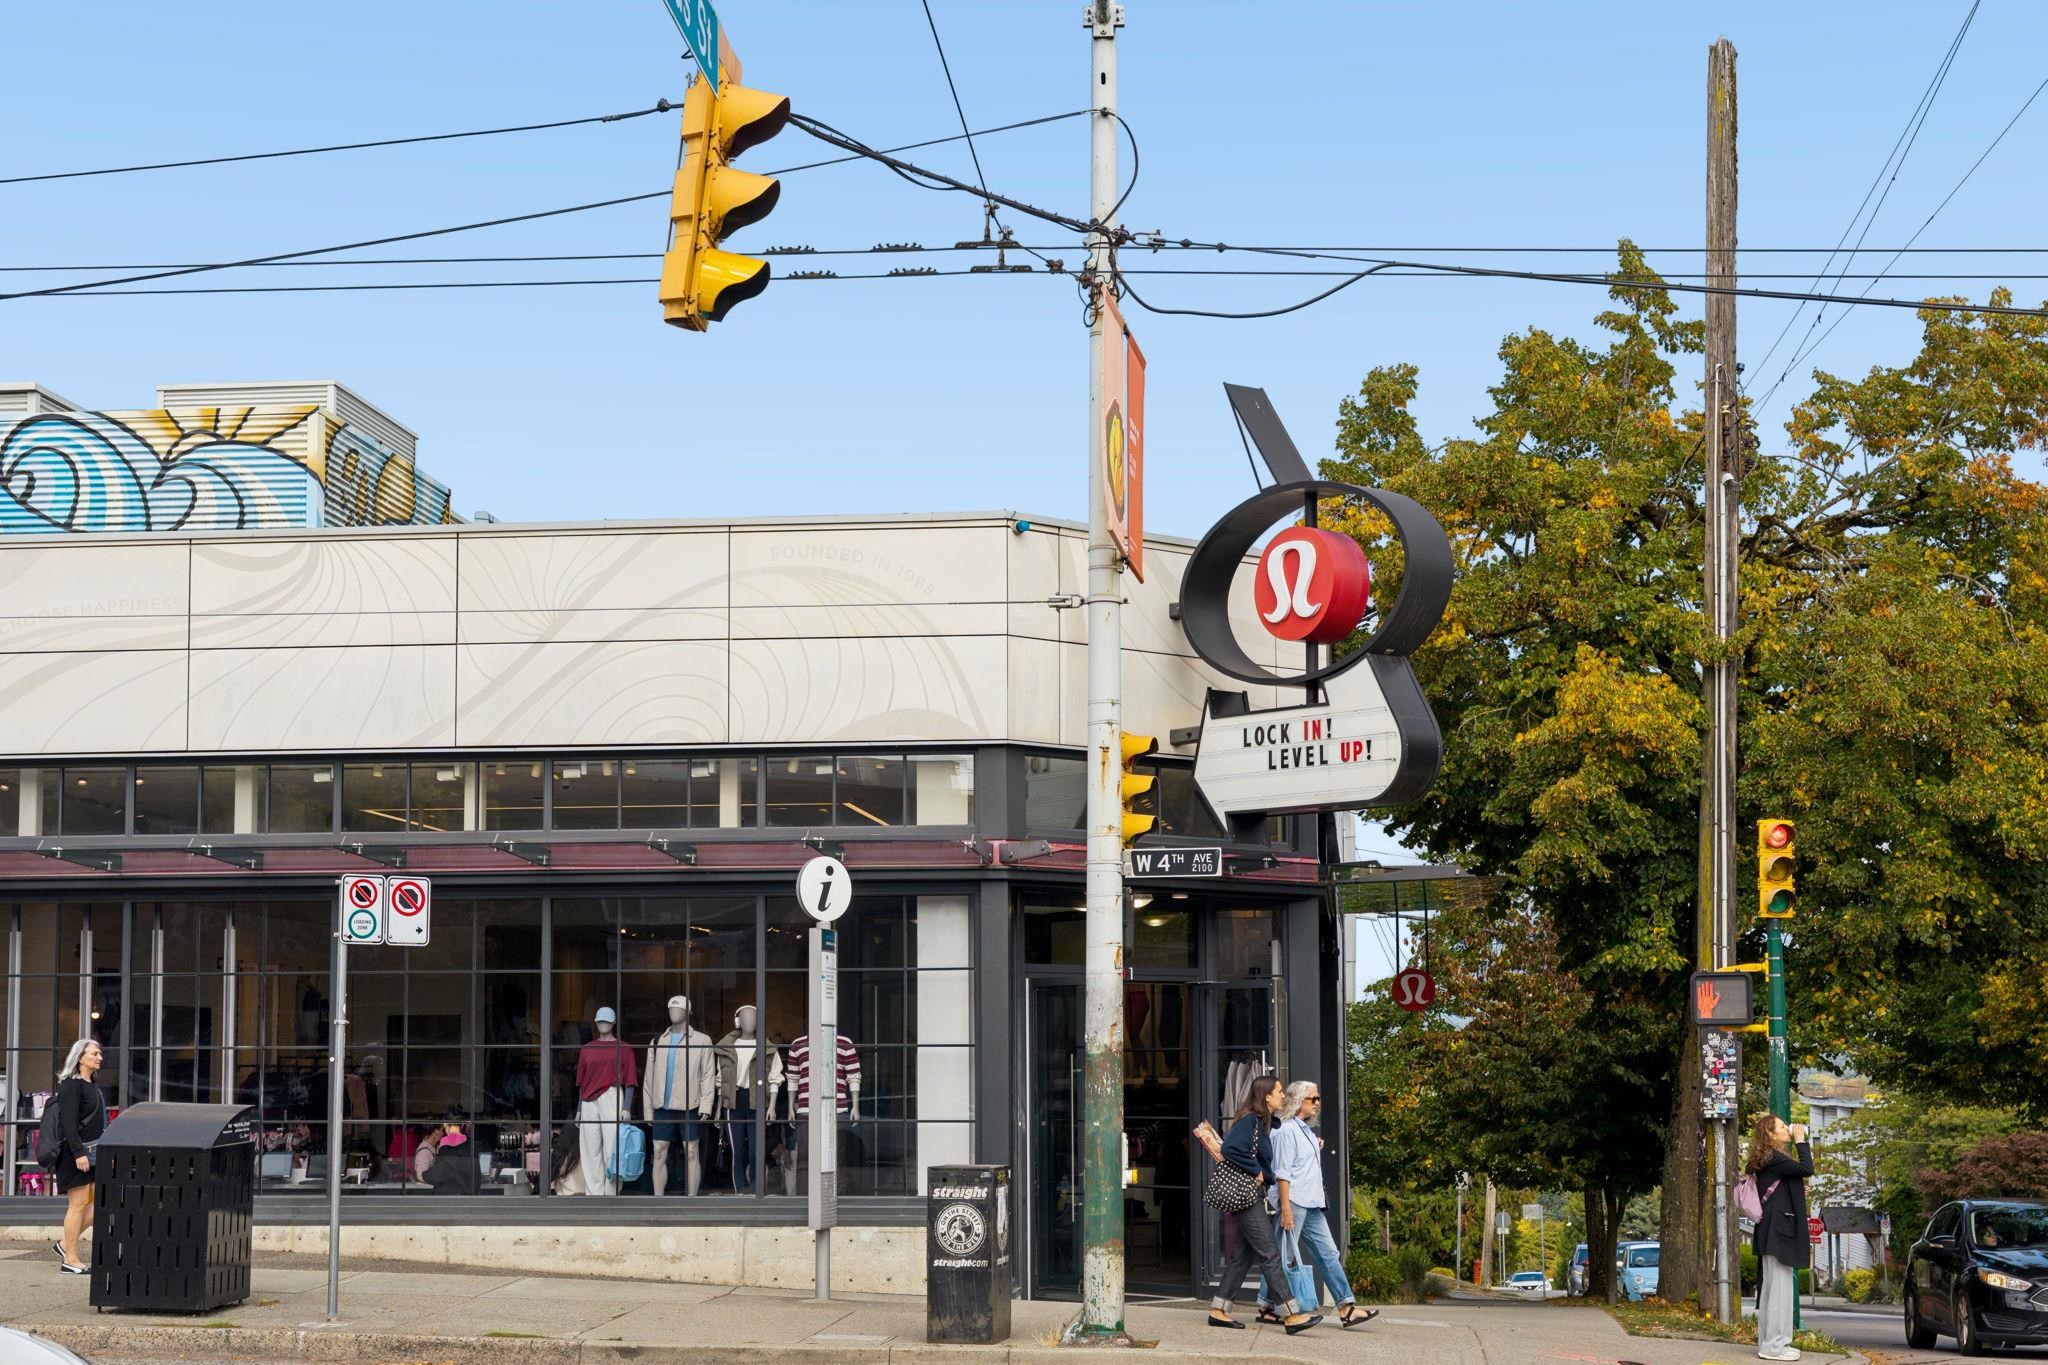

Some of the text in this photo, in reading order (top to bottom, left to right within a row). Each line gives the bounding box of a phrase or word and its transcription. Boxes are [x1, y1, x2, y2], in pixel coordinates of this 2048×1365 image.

[697, 0, 712, 69] St
[770, 545, 936, 596] FOUNDED IN 1998
[0, 597, 184, 636] CHOOSE HAPPINESS
[1243, 718, 1332, 748] LOCK IN!
[1268, 740, 1372, 770] LEVEL UP!
[1136, 853, 1212, 872] W 4TH AVE
[1191, 863, 1213, 872] 2100
[932, 1185, 988, 1200] straight
[947, 1208, 960, 1217] THE
[961, 1208, 981, 1226] STREET
